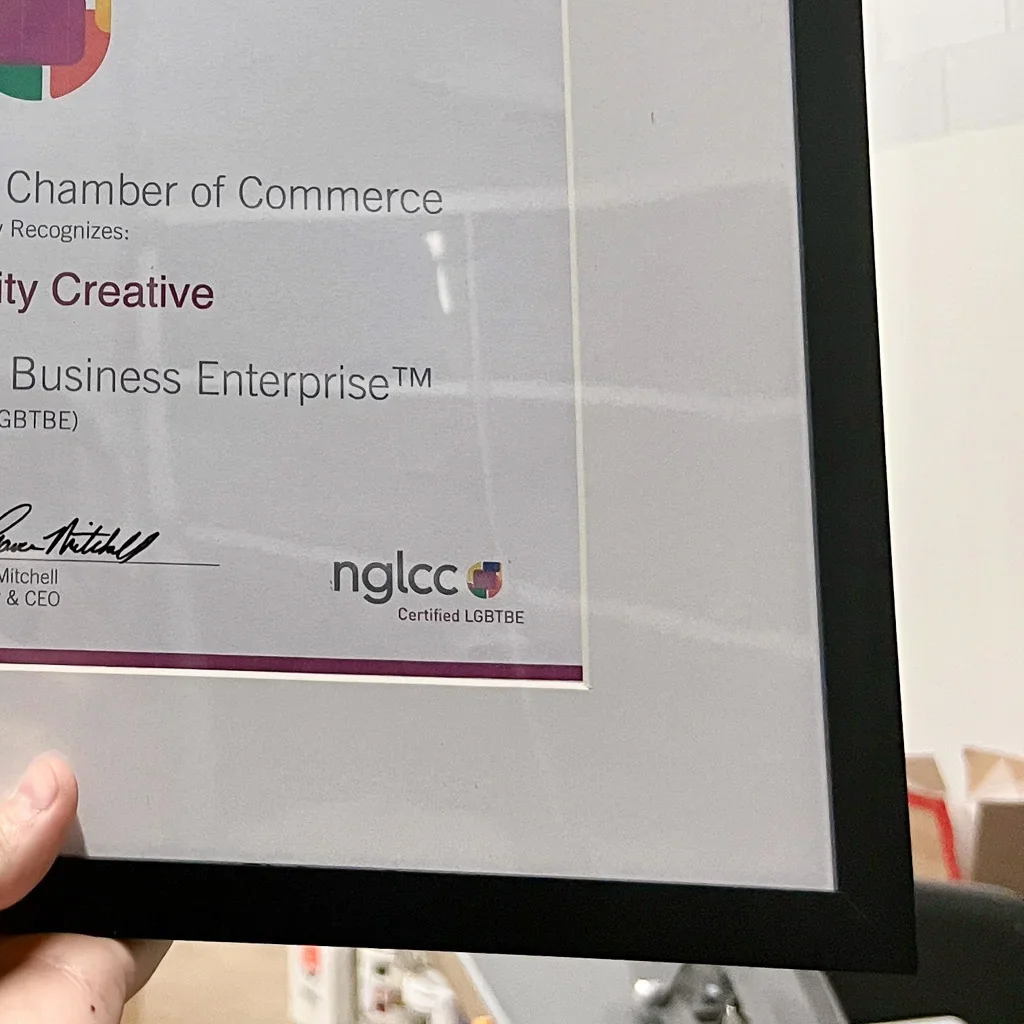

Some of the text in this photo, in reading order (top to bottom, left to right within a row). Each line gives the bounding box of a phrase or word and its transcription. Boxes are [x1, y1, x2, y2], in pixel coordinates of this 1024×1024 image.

[7, 170, 178, 207] Chamber
[191, 174, 227, 209] of
[238, 175, 444, 215] Commerce
[11, 218, 130, 243] Recognizes:
[52, 271, 215, 309] Creative
[12, 355, 182, 394] Business
[334, 550, 458, 604] nglcc
[7, 589, 19, 606] &
[25, 589, 60, 607] CEO
[398, 607, 525, 624] Certified LGBTBE
